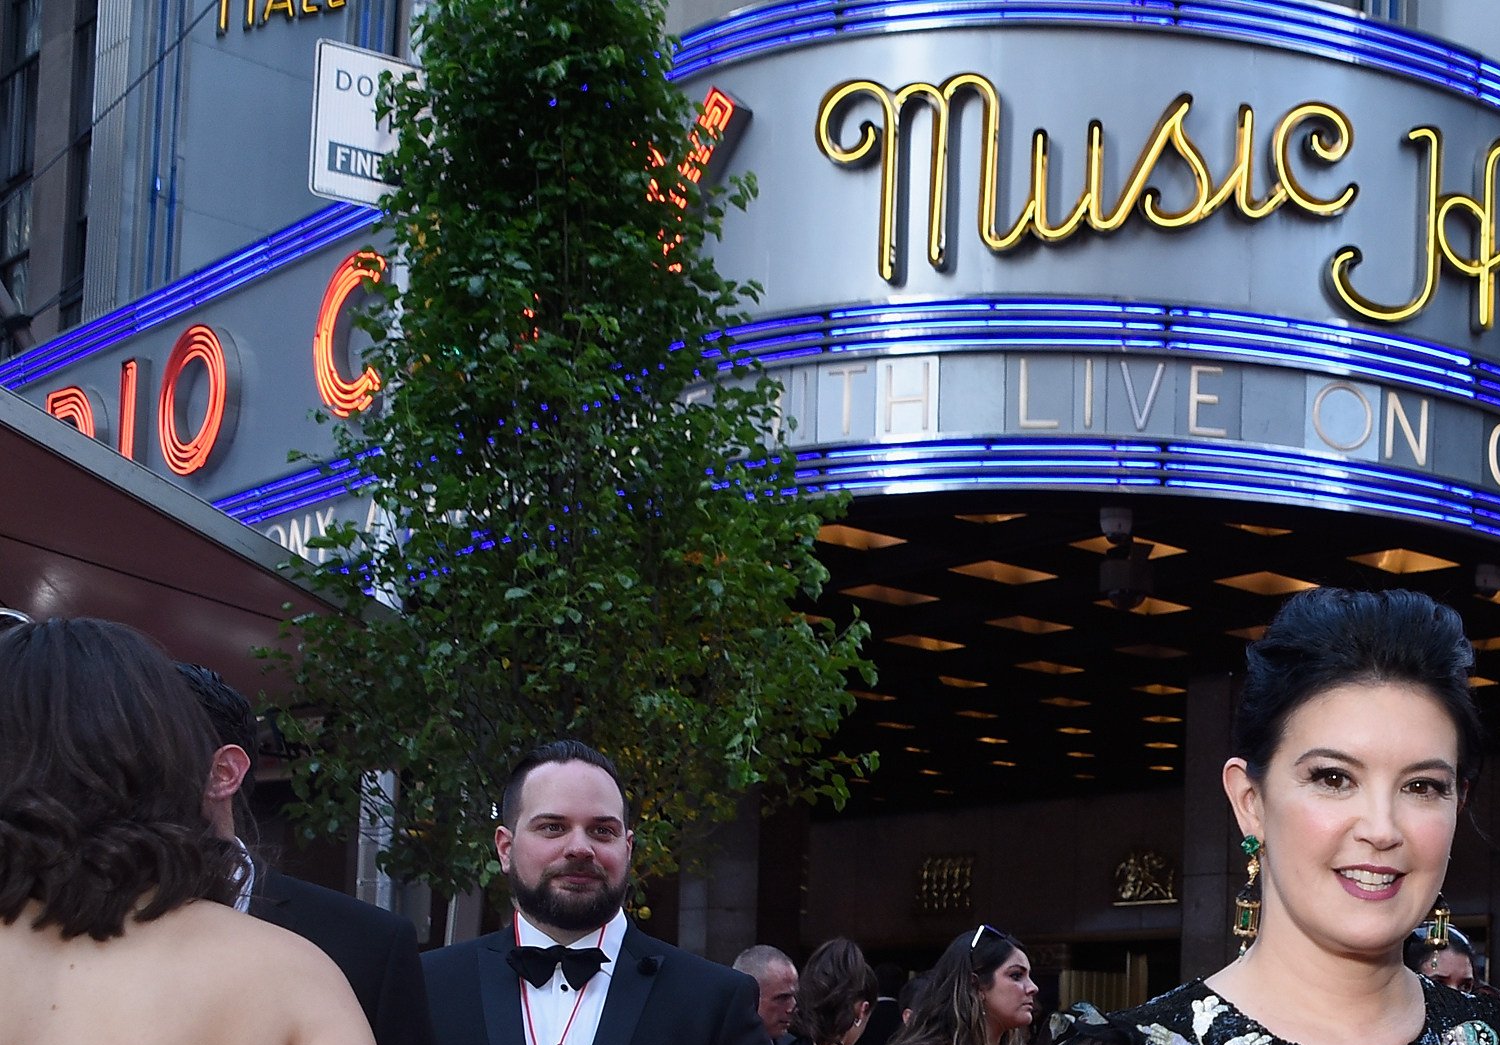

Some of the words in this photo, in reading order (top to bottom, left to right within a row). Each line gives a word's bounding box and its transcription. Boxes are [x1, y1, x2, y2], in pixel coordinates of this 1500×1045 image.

[816, 73, 1357, 282] Music
[1018, 357, 1228, 438] LIVE
[1312, 380, 1428, 467] ON
